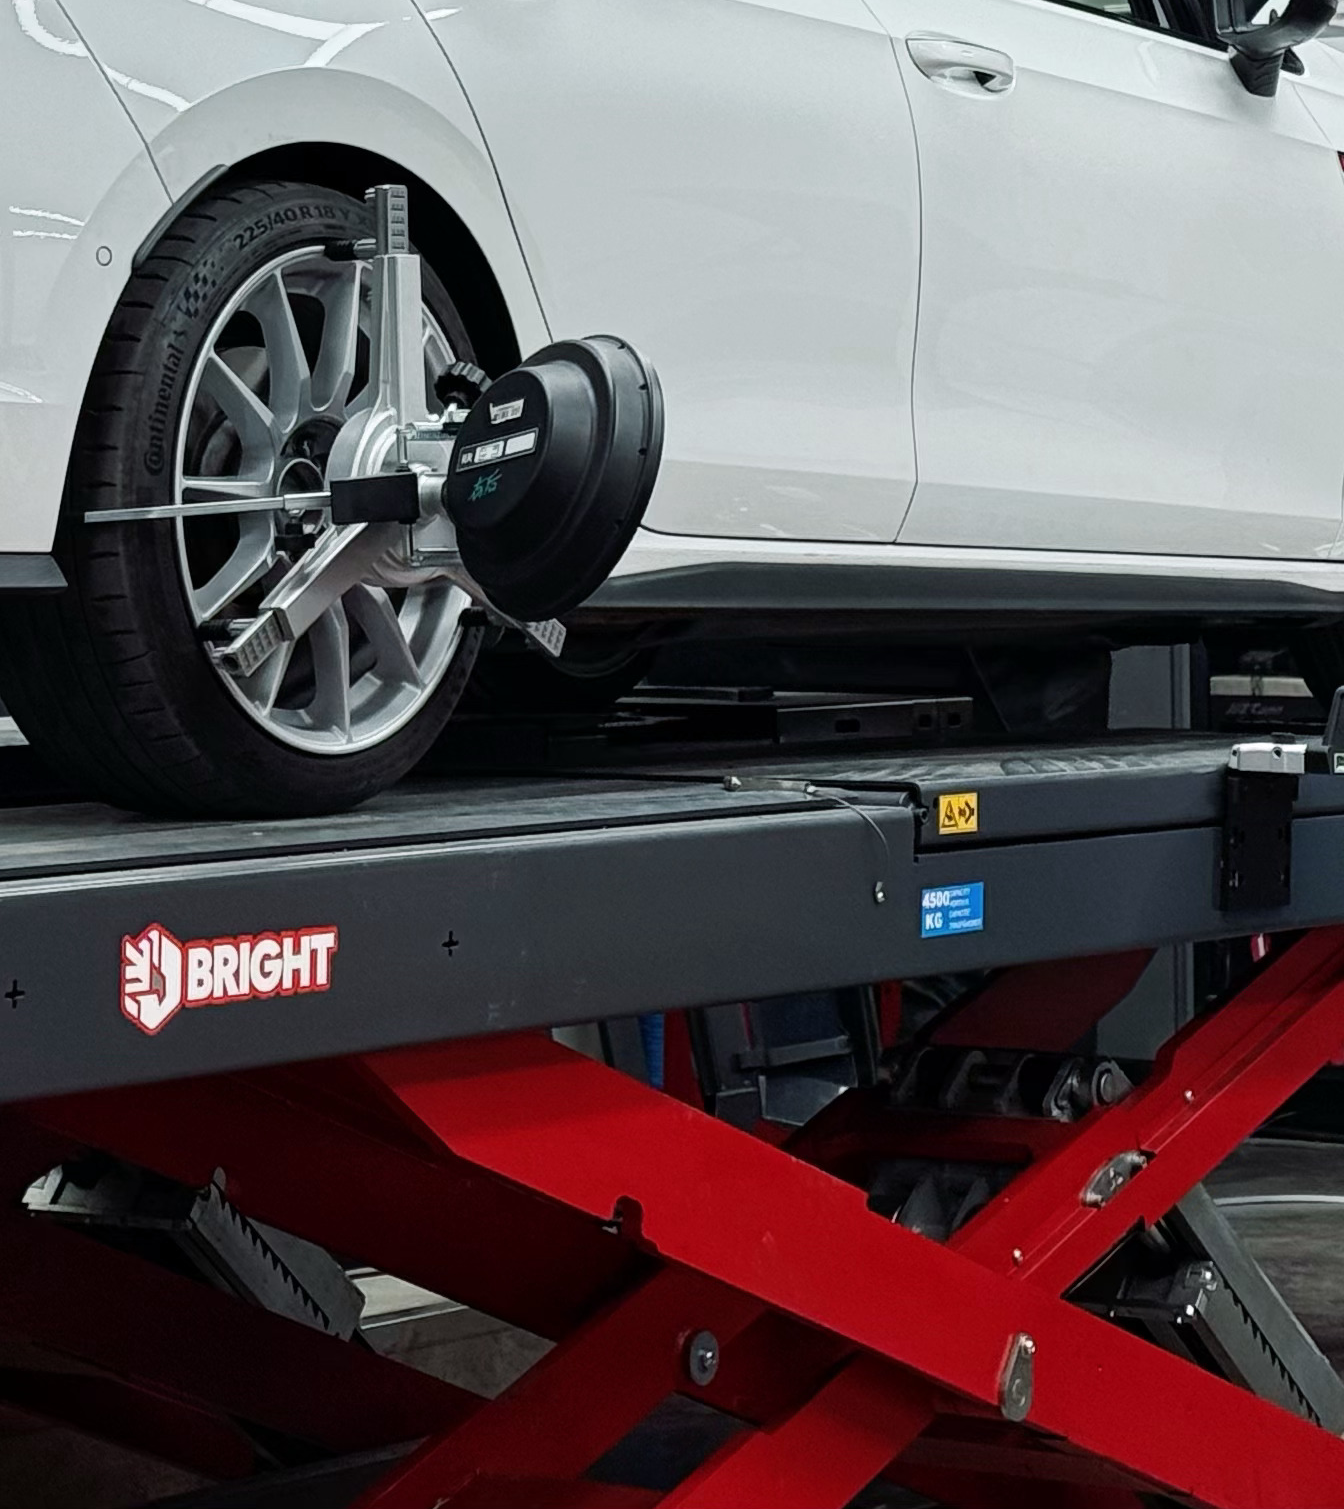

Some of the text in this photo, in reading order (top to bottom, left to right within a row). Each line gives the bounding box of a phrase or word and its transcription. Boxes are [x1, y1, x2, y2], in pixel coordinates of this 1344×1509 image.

[233, 206, 299, 251] 225/40
[143, 342, 186, 476] Continental
[922, 890, 950, 910] 4500
[925, 911, 944, 931] KG
[186, 932, 336, 1002] BRIGHT
